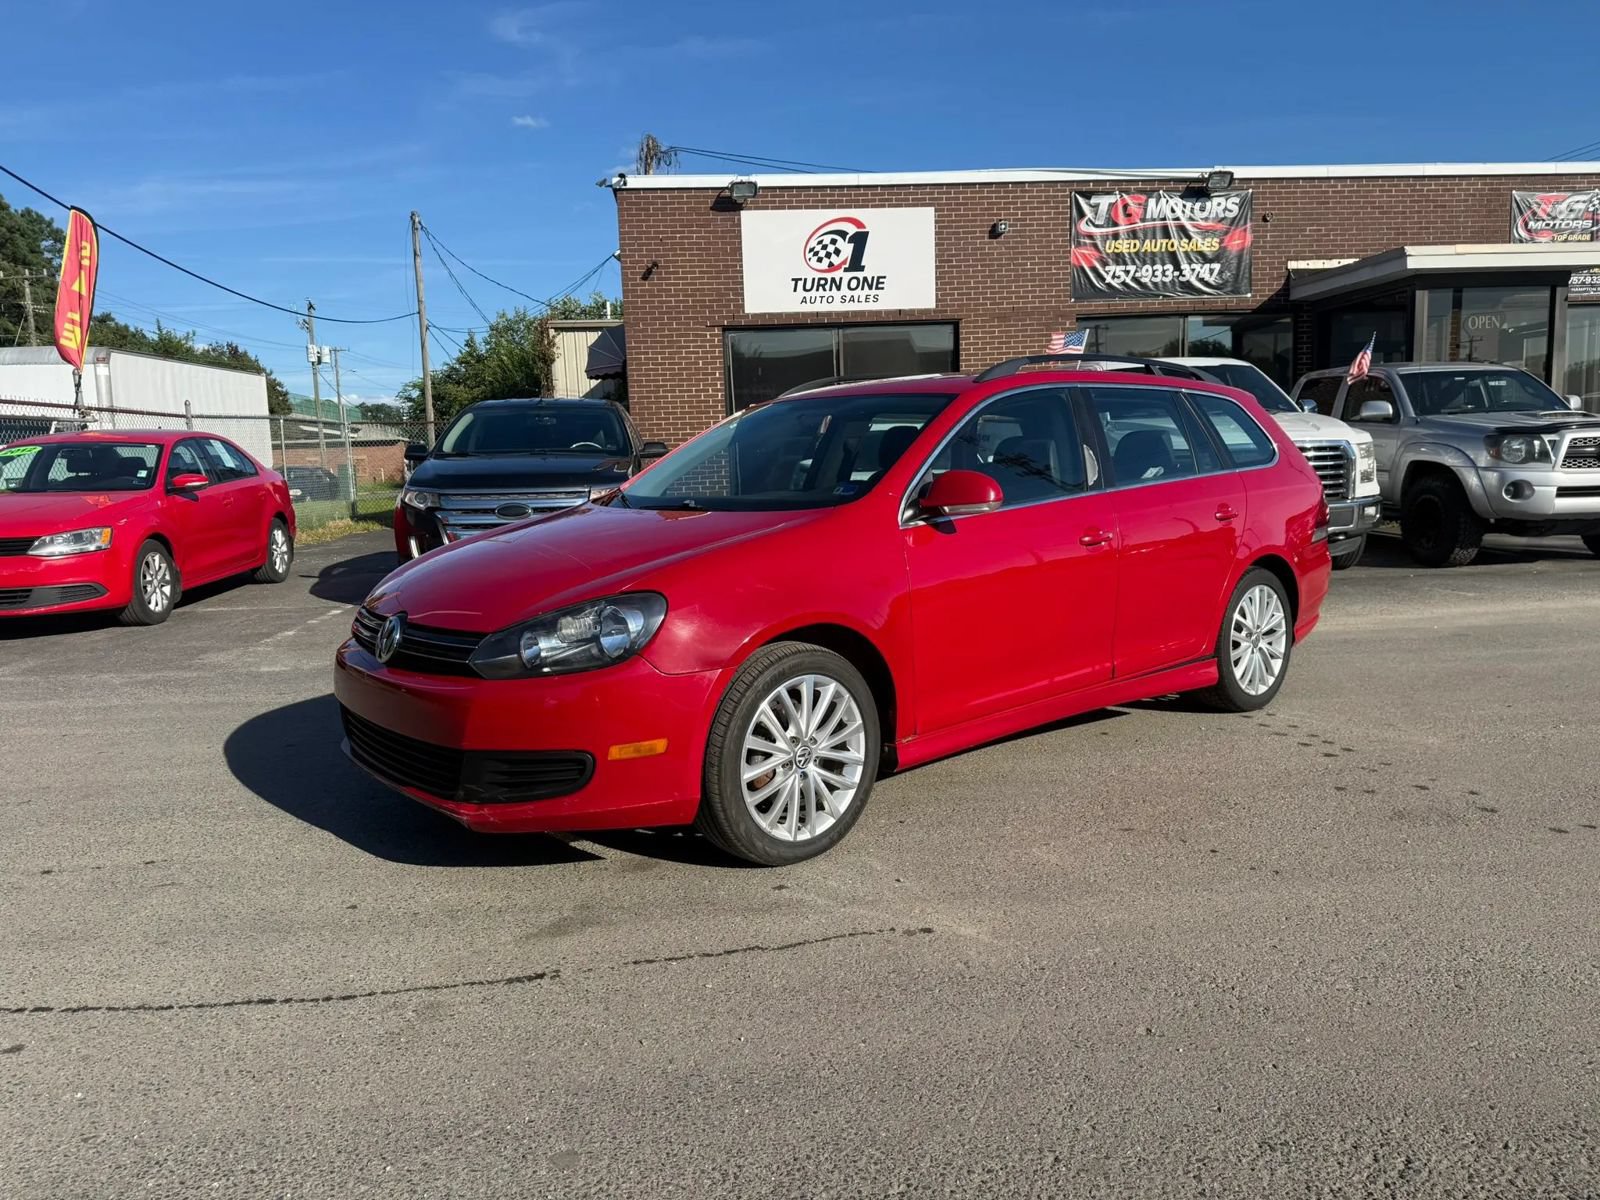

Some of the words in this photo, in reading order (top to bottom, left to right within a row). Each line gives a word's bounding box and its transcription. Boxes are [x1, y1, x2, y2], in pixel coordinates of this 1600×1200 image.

[1090, 194, 1147, 225] TG
[1146, 197, 1241, 219] MOTORS
[1528, 220, 1593, 229] MOTORS
[1568, 233, 1591, 241] GRADE
[1105, 240, 1139, 254] USED
[1141, 239, 1178, 253] AUTO
[1178, 238, 1220, 252] SALES
[1104, 263, 1221, 283] 757-933-3747
[791, 277, 843, 293] TURN
[847, 275, 887, 291] ONE
[800, 295, 835, 305] AUTO
[840, 294, 879, 304] SALES
[1468, 315, 1500, 330] OPEN
